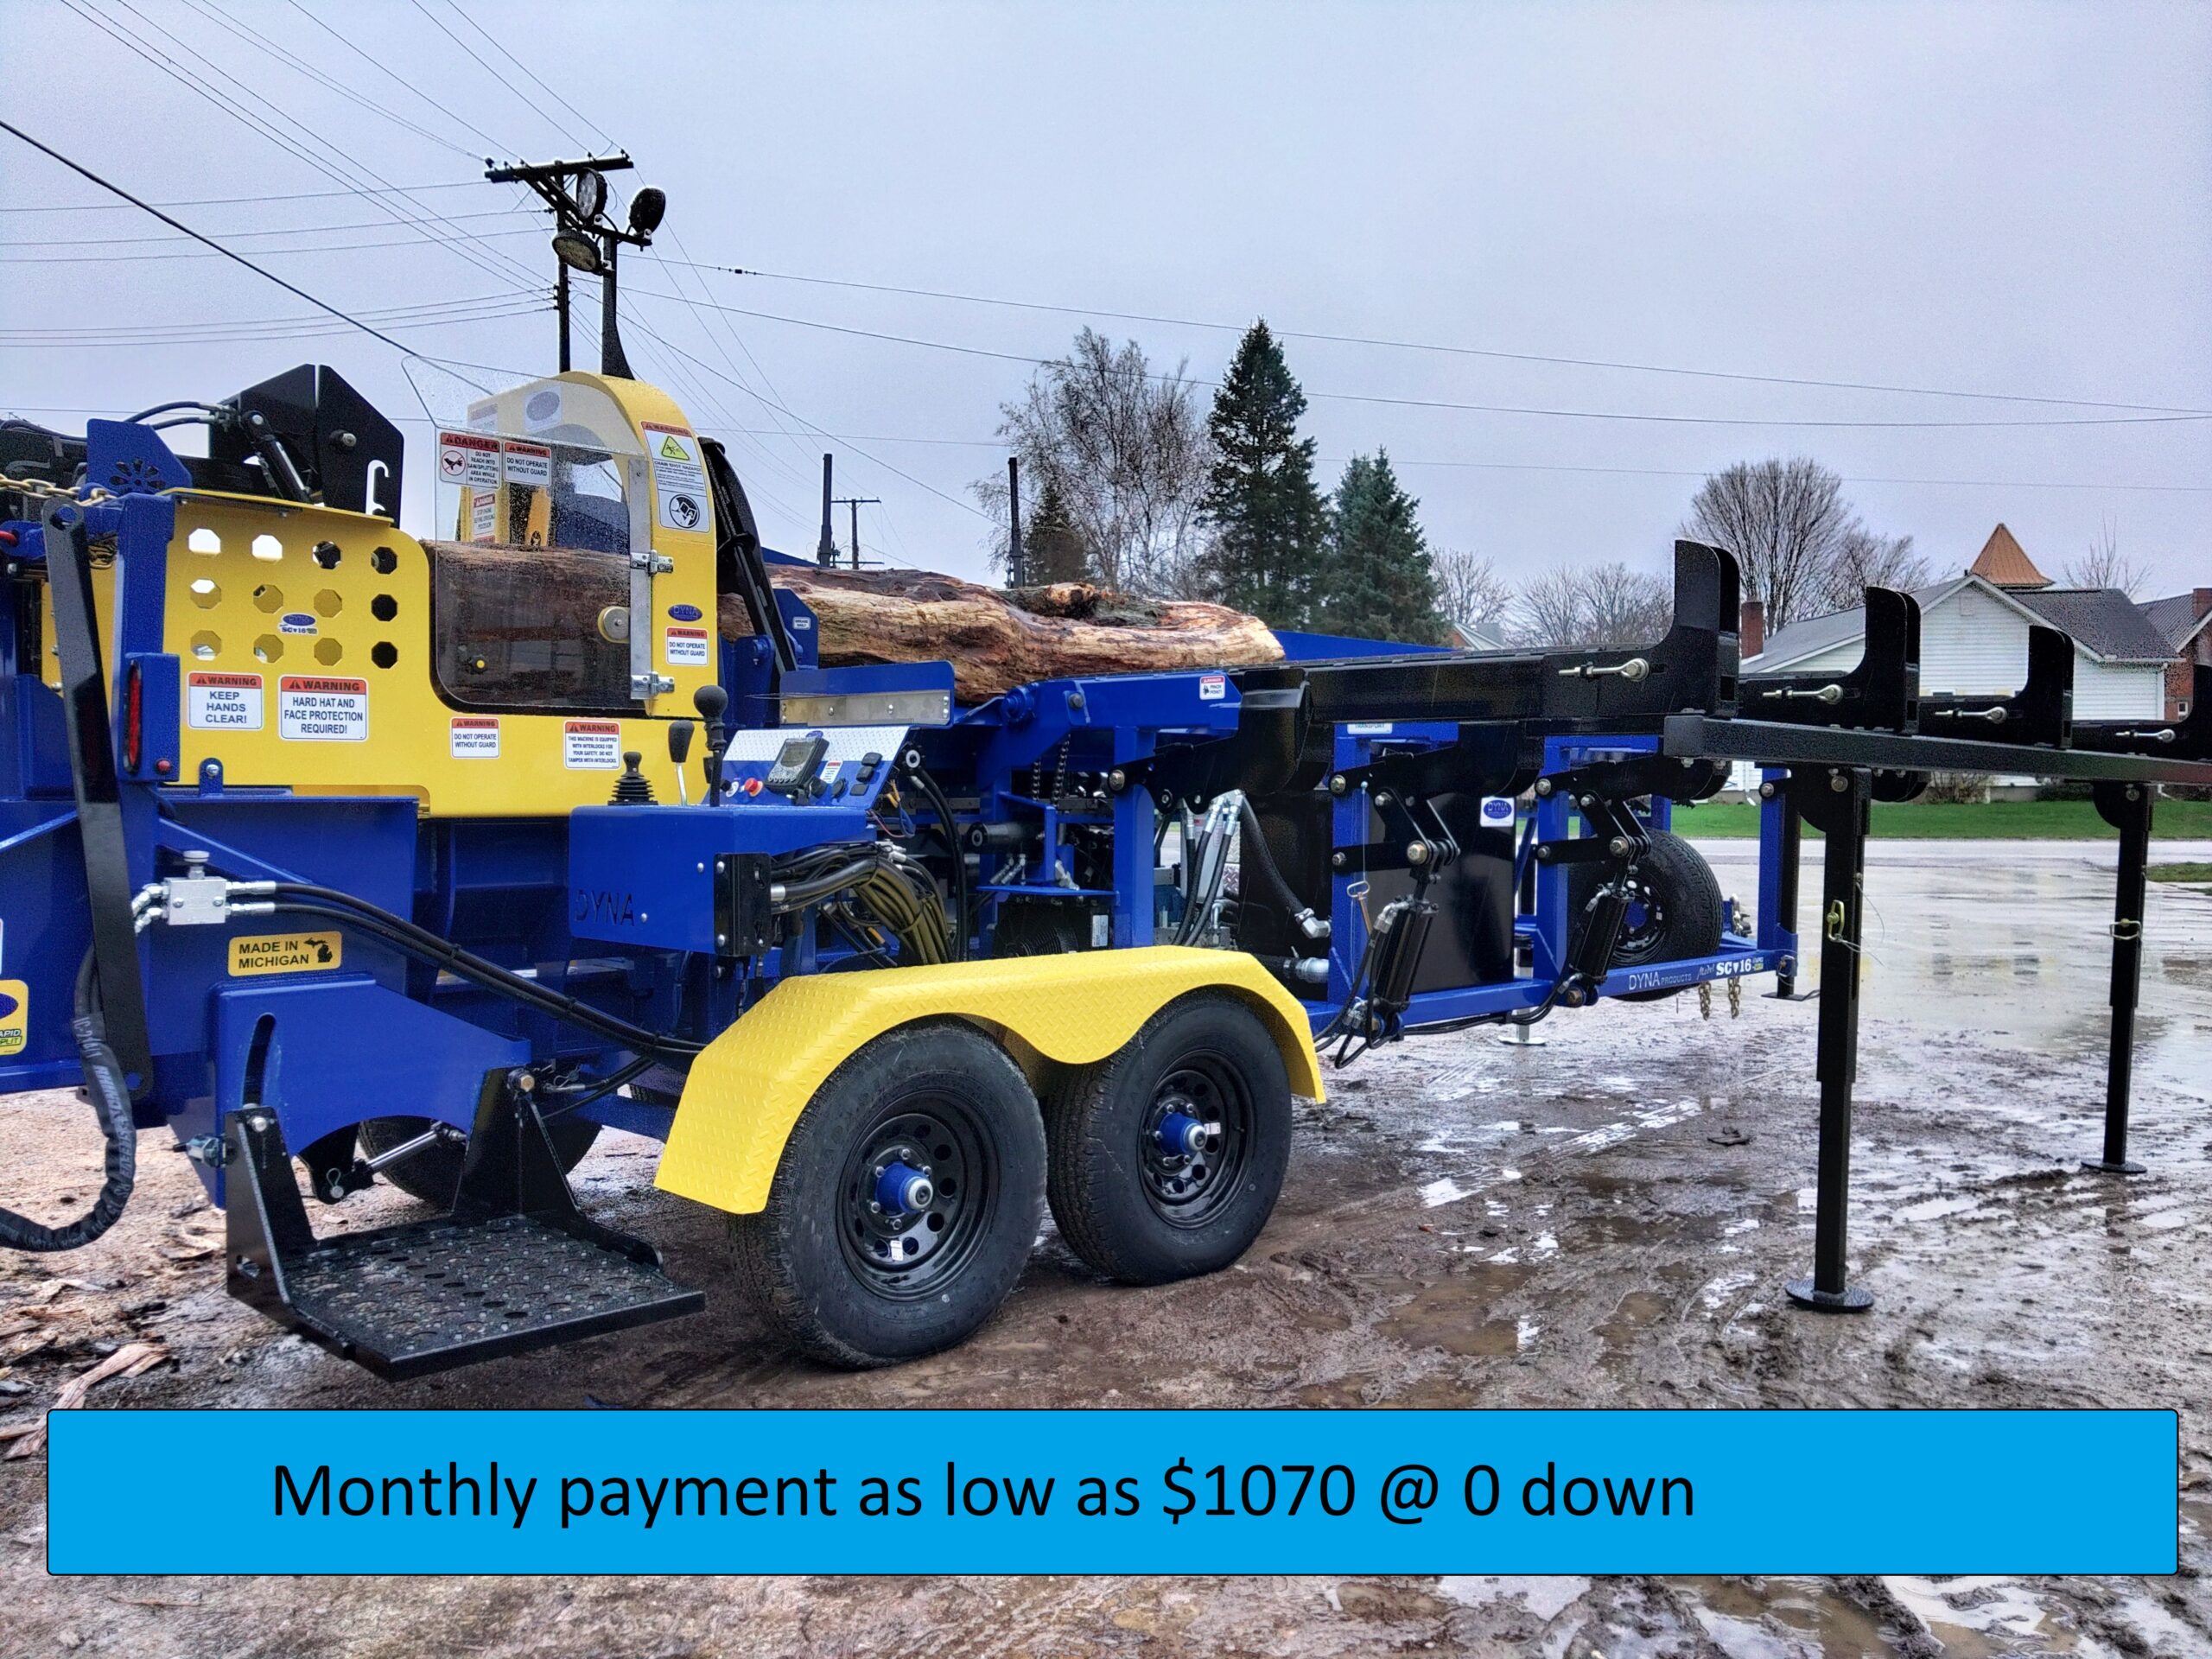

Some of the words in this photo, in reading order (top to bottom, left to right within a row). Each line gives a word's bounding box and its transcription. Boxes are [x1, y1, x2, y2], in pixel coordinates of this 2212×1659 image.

[454, 435, 499, 450] DANGER
[518, 446, 548, 456] WARNING
[515, 458, 525, 467] NOT
[525, 460, 549, 469] OPERATE
[507, 465, 530, 474] WITHOUT
[530, 468, 549, 477] GUARD
[207, 676, 257, 686] WARNING
[302, 679, 360, 691] WARNING
[209, 690, 240, 701] KEEP
[207, 702, 246, 713] HANDS
[292, 696, 318, 707] HARD
[319, 697, 336, 708] HAT
[337, 698, 355, 709] AND
[205, 714, 247, 724] CLEAR!
[284, 709, 308, 720] FACE
[308, 710, 363, 721] PROTECTION
[301, 723, 347, 734] REQUIRED!
[579, 724, 616, 733] WARNING
[574, 889, 635, 927] DYNA
[238, 941, 281, 955] MADE
[284, 940, 299, 951] IN
[238, 954, 309, 969] MICHIGAN
[1629, 971, 1661, 991] DYNA
[1661, 973, 1692, 986] PRODUCTS
[0, 1029, 21, 1038] APID
